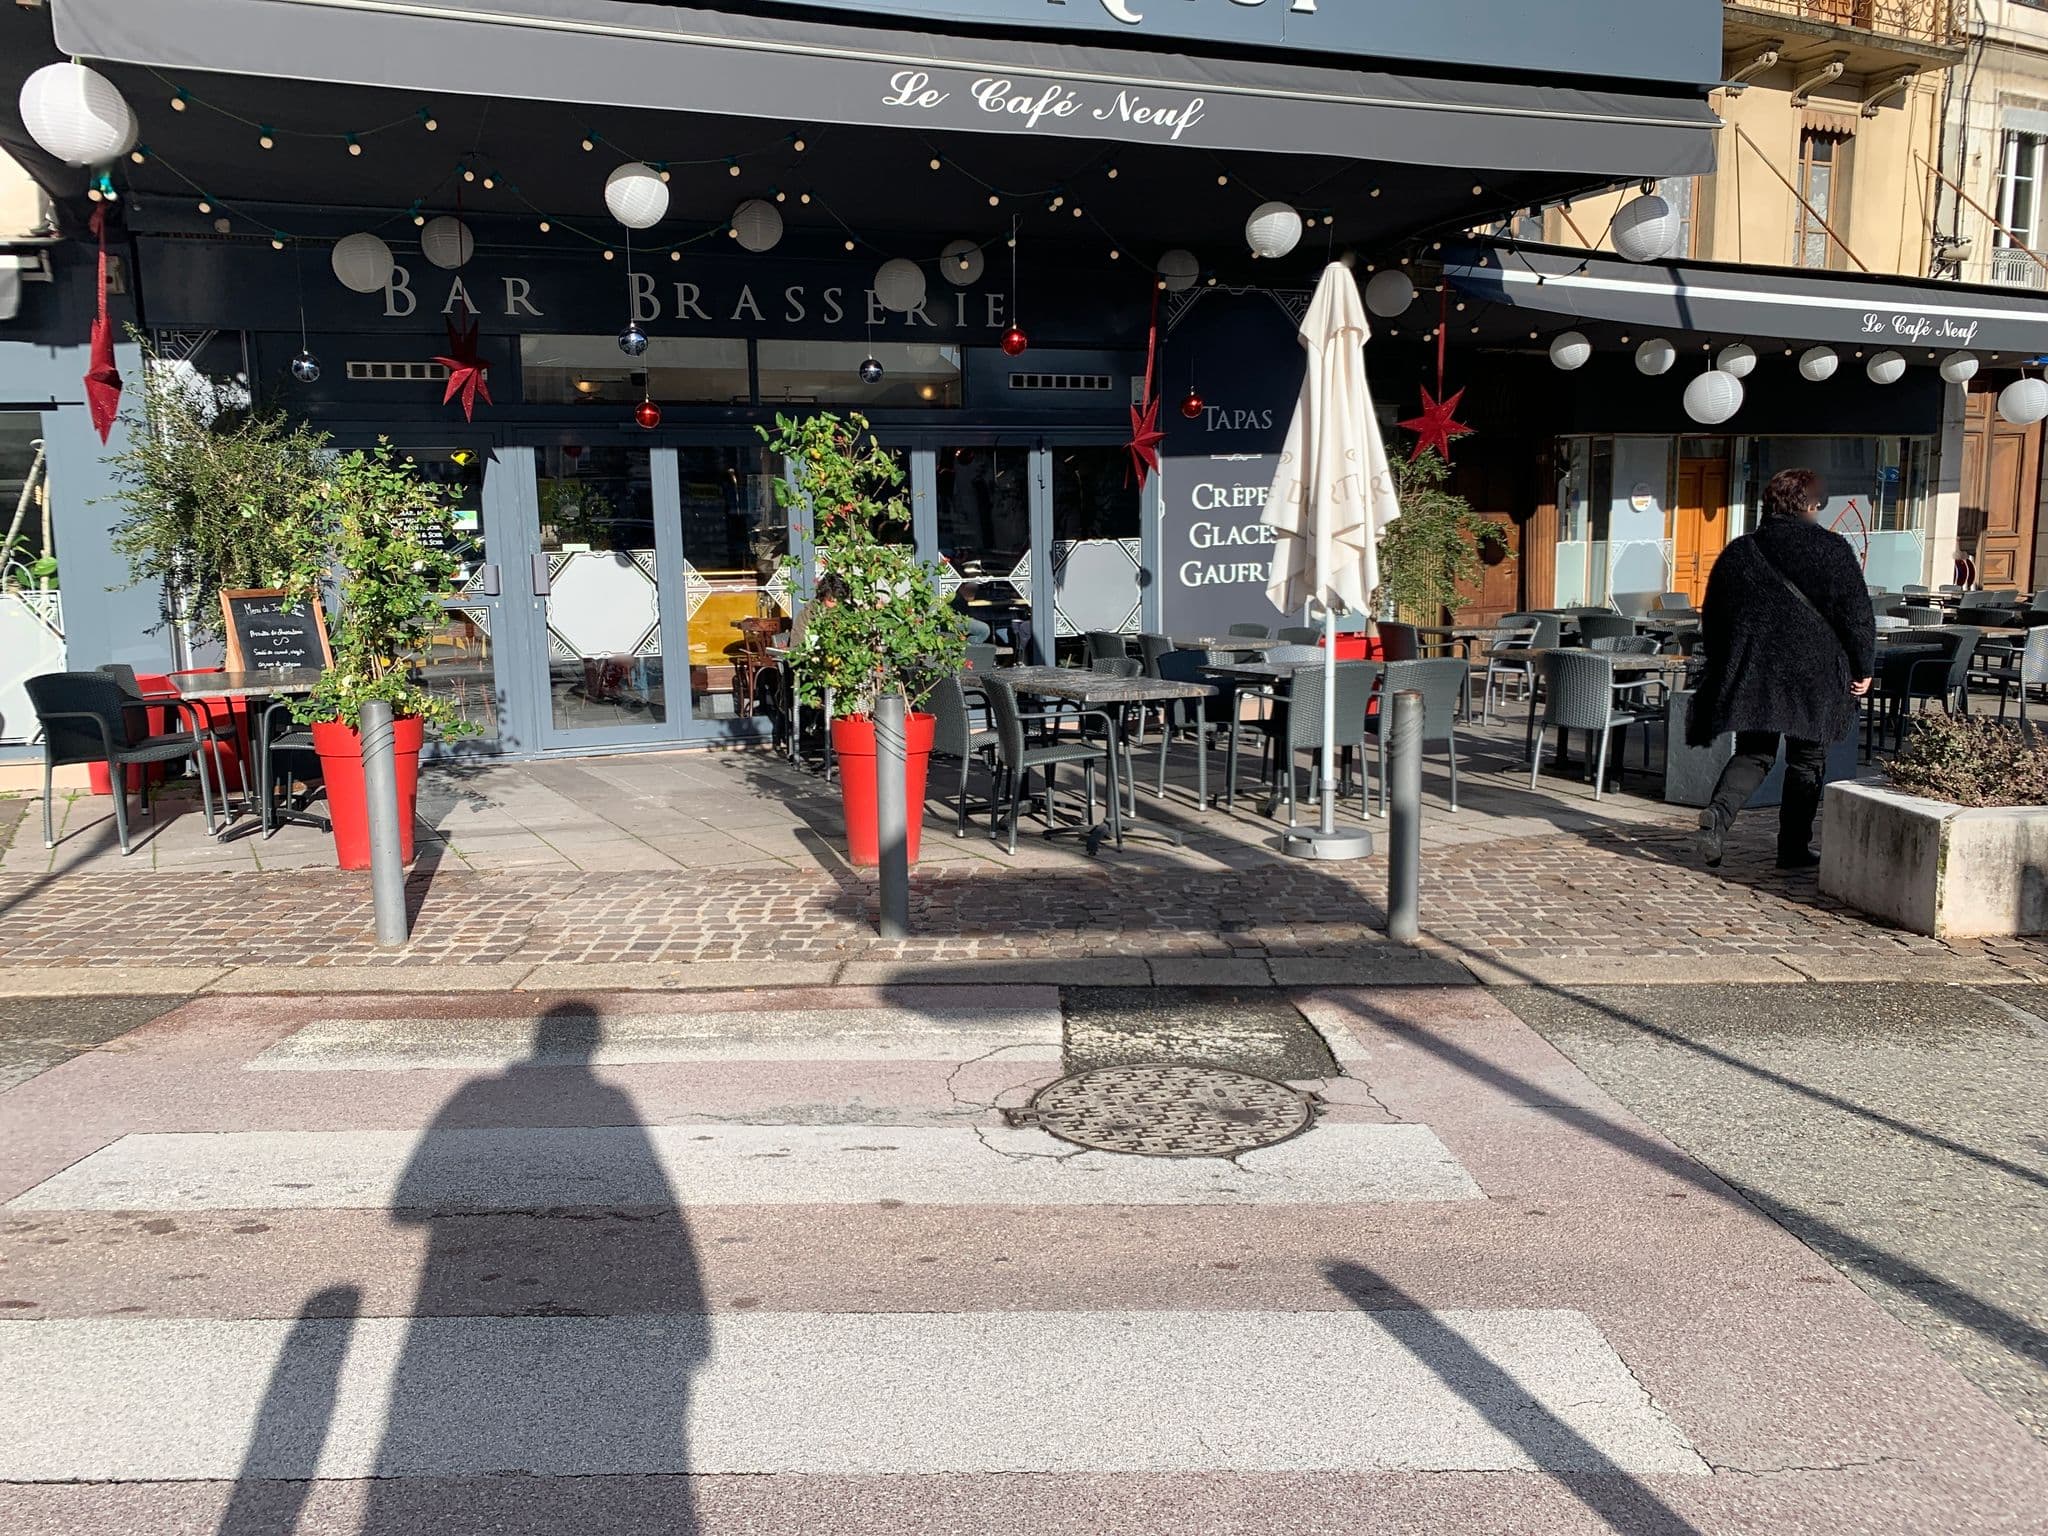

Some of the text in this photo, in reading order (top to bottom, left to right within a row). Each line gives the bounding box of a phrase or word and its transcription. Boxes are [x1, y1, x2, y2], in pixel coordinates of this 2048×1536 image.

[882, 71, 1205, 140] Le Café Neuf
[382, 265, 545, 317] BAR
[1861, 313, 1979, 346] Le Café Neuf
[1202, 405, 1273, 432] TAPAS
[1191, 482, 1270, 510] CRÊPE
[1179, 560, 1273, 588] GAUFR
